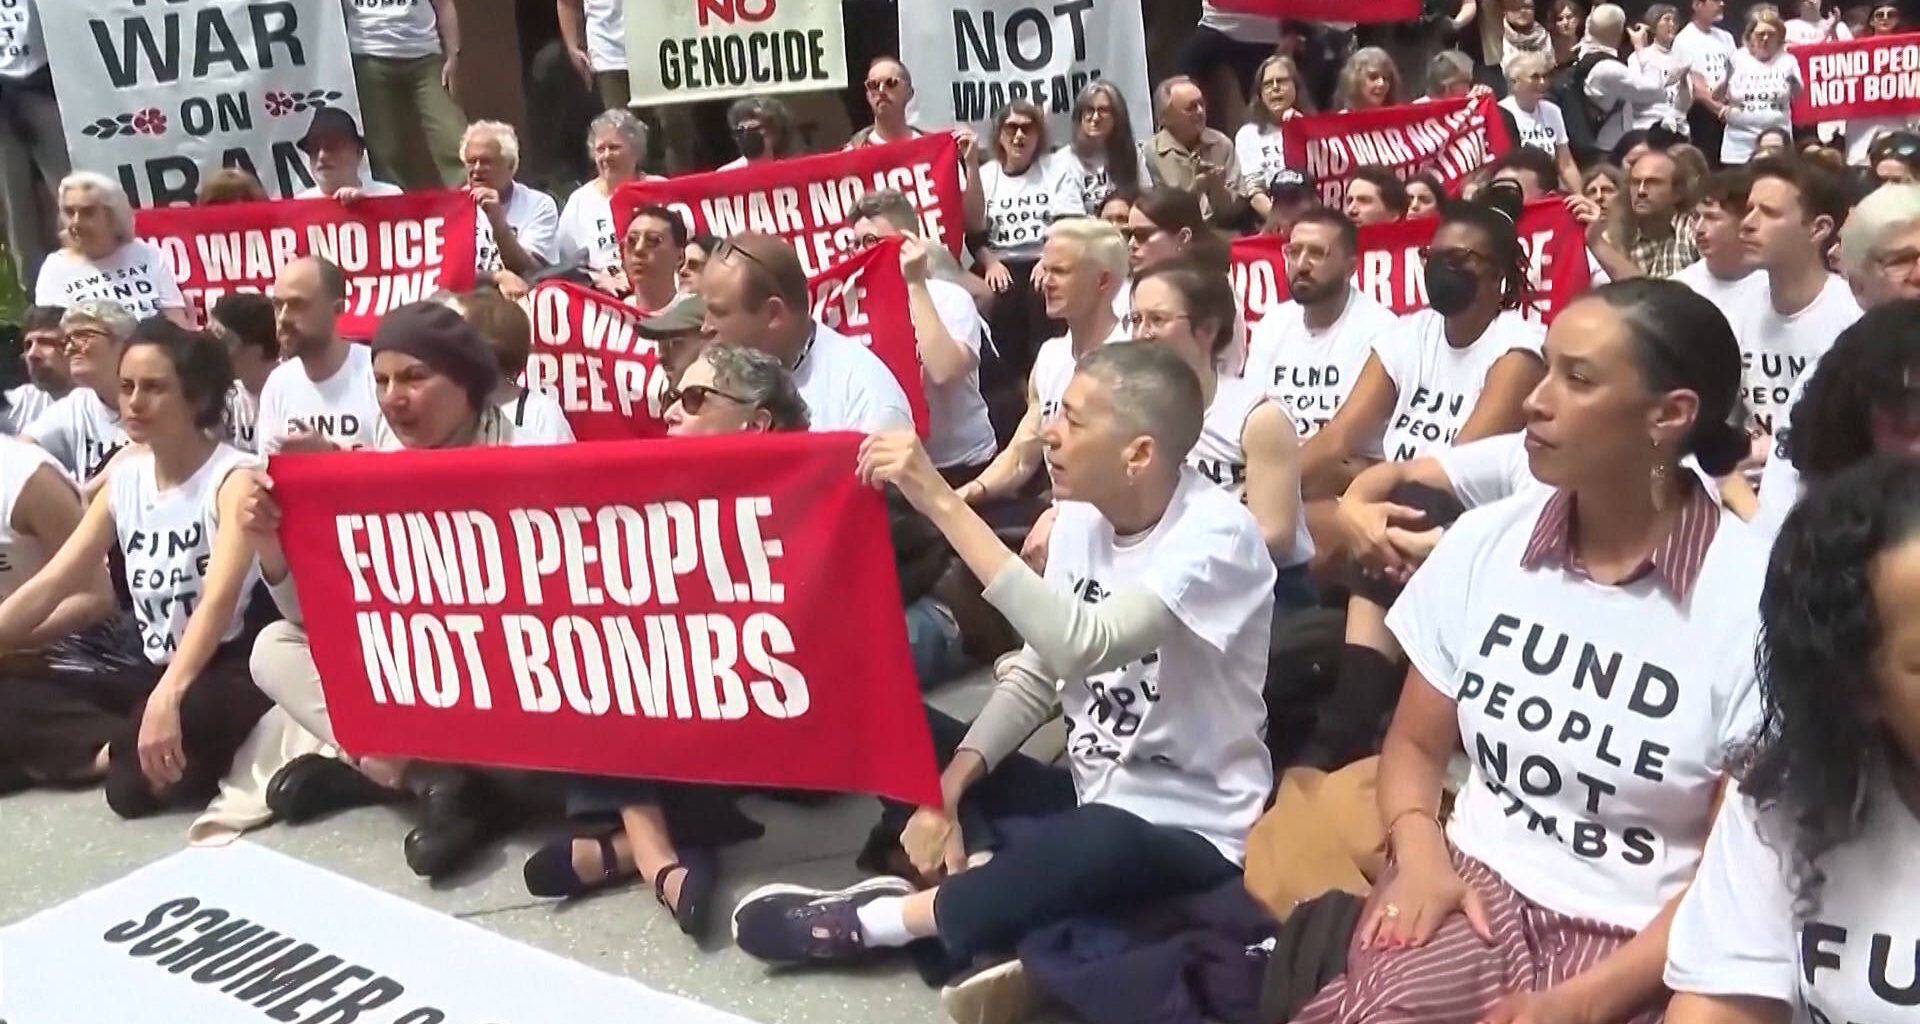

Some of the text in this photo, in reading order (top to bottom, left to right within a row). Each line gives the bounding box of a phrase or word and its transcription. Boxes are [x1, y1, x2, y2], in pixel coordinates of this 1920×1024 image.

[696, 0, 776, 26] NO
[953, 0, 1094, 72] NOT
[89, 2, 305, 88] WAR
[659, 29, 829, 90] GENOCIDE
[1809, 44, 1920, 81] FUND PEO
[180, 91, 252, 136] ON
[952, 69, 1101, 122] WARFAR
[1811, 77, 1858, 108] NOT
[1346, 128, 1415, 166] WAR
[702, 186, 806, 241] WAR
[998, 224, 1041, 242] NOT
[66, 263, 149, 295] JEWS SAY
[196, 226, 297, 282] WAR
[307, 221, 368, 272] NO
[379, 216, 445, 269] ICE
[517, 353, 614, 412] REE
[335, 495, 786, 606] FUND PEOPLE
[355, 611, 811, 721] NOT BOMBS
[1479, 612, 1680, 719] FUND
[1457, 671, 1671, 783] PEOPLE
[1476, 731, 1617, 815] NOT
[103, 896, 405, 1024] SCHUMER
